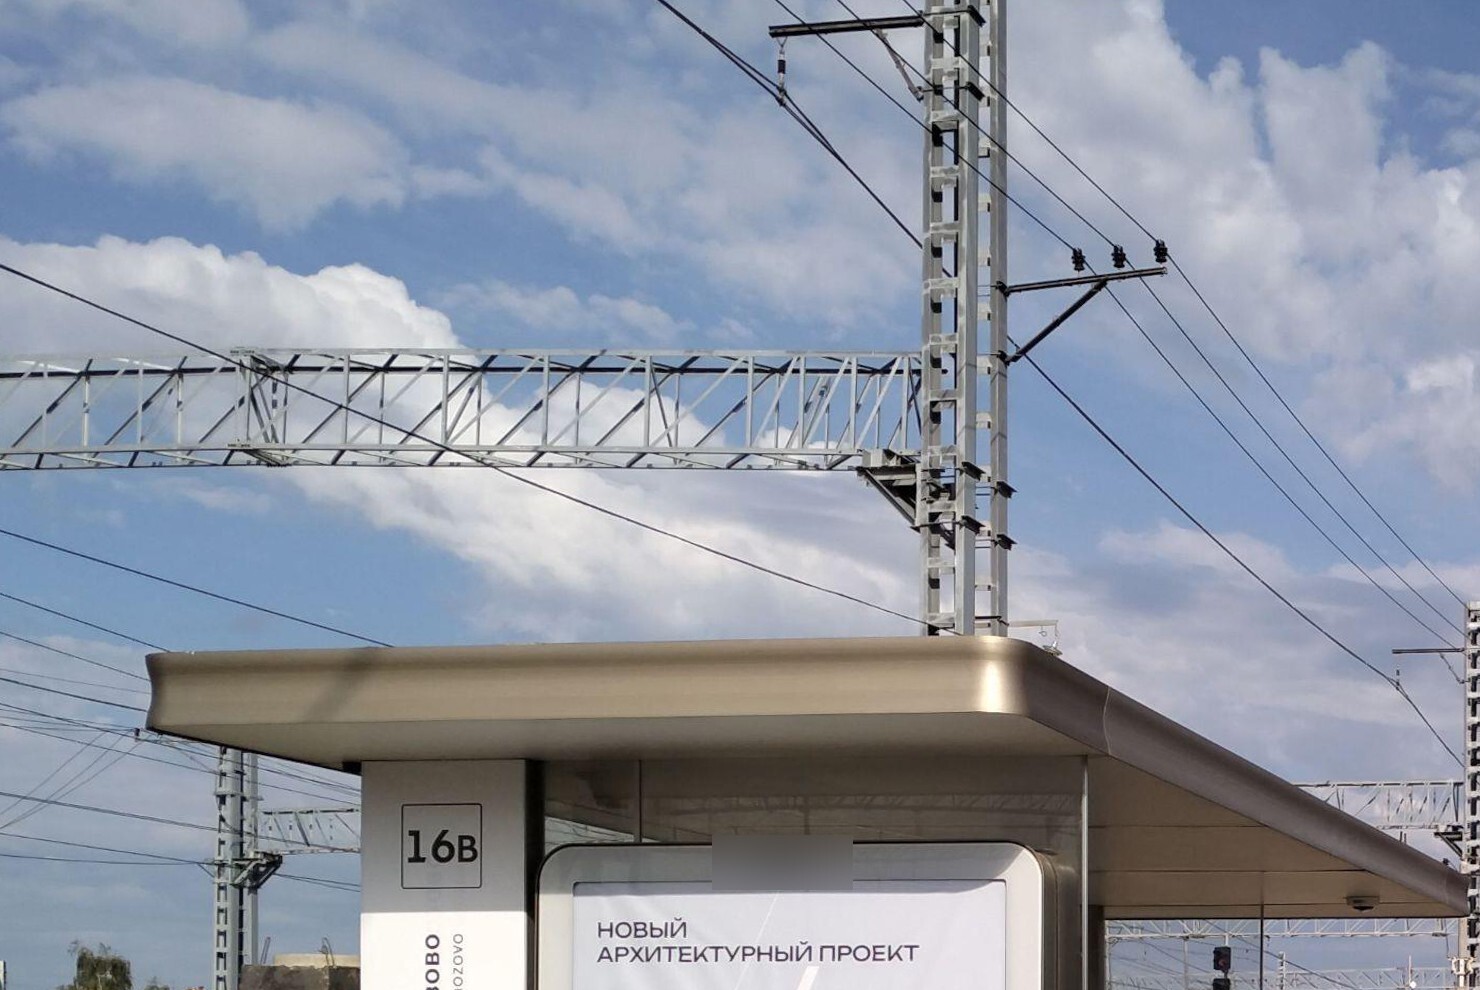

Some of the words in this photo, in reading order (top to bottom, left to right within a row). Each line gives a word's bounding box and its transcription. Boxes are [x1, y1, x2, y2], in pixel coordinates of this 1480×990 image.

[597, 916, 687, 939] НОВЫЙ
[596, 940, 813, 963] АРХИТЕКТУРНЫЙ
[819, 944, 920, 962] ПРОЕКТ
